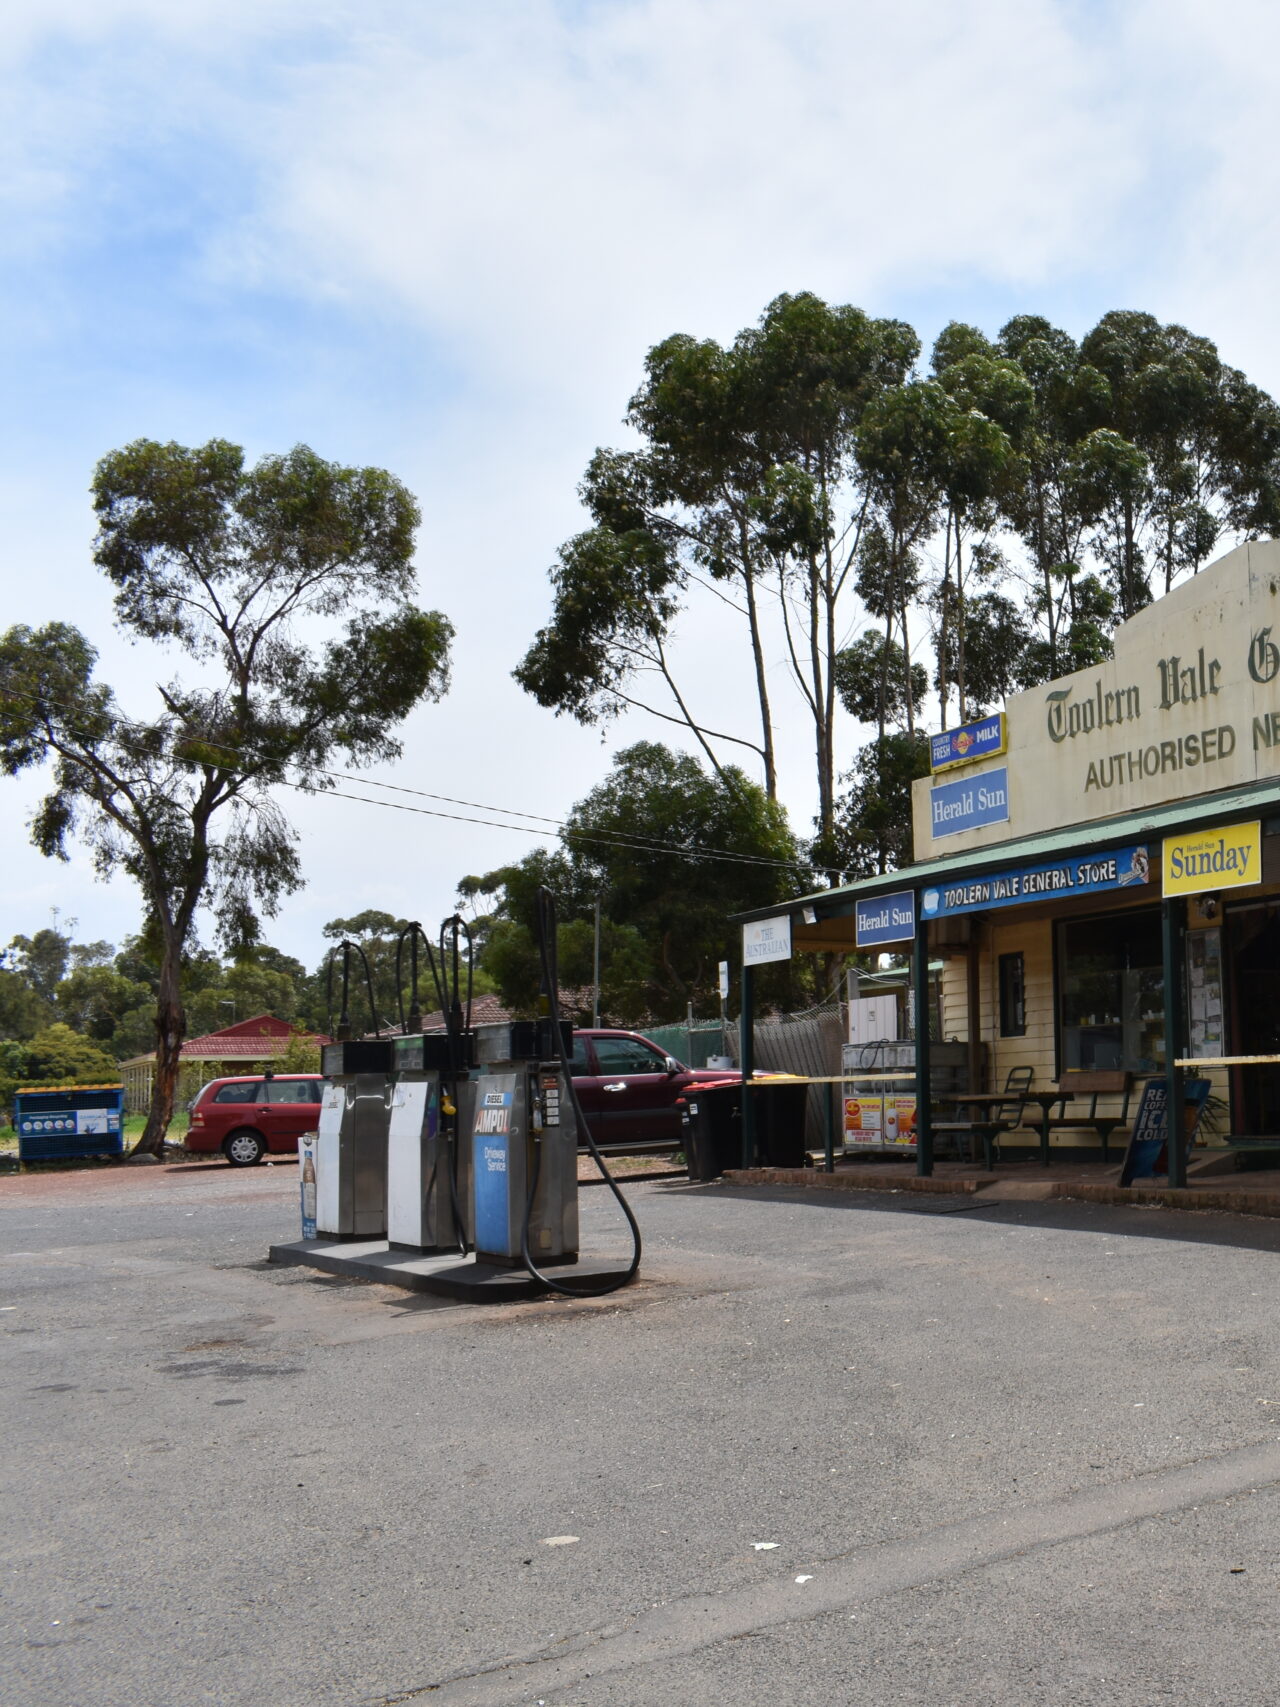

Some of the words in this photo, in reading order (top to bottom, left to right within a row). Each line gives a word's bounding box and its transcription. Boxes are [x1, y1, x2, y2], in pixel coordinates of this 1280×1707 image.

[1045, 678, 1142, 744] Toolern
[1157, 646, 1222, 711] Vale
[976, 725, 999, 743] MILK
[933, 744, 951, 761] FRESH
[1084, 725, 1236, 793] AUTHORISED
[933, 791, 974, 823] Herald
[978, 788, 1006, 810] Sun
[1187, 843, 1204, 853] Herald
[1205, 842, 1215, 850] Sun
[1171, 839, 1252, 879] Sunday
[944, 882, 990, 908] TOOLERN
[993, 877, 1019, 900] VALE
[1023, 867, 1074, 894] GENERAL
[1077, 859, 1117, 885] STORE
[858, 910, 890, 932] Herald
[892, 909, 913, 925] Sun
[761, 927, 774, 941] THE
[746, 939, 789, 958] AUSTRALIAN
[487, 1094, 502, 1104] DIESEL
[1146, 1089, 1168, 1101] RE
[474, 1109, 510, 1132] AMPOL
[487, 1159, 506, 1171] Service
